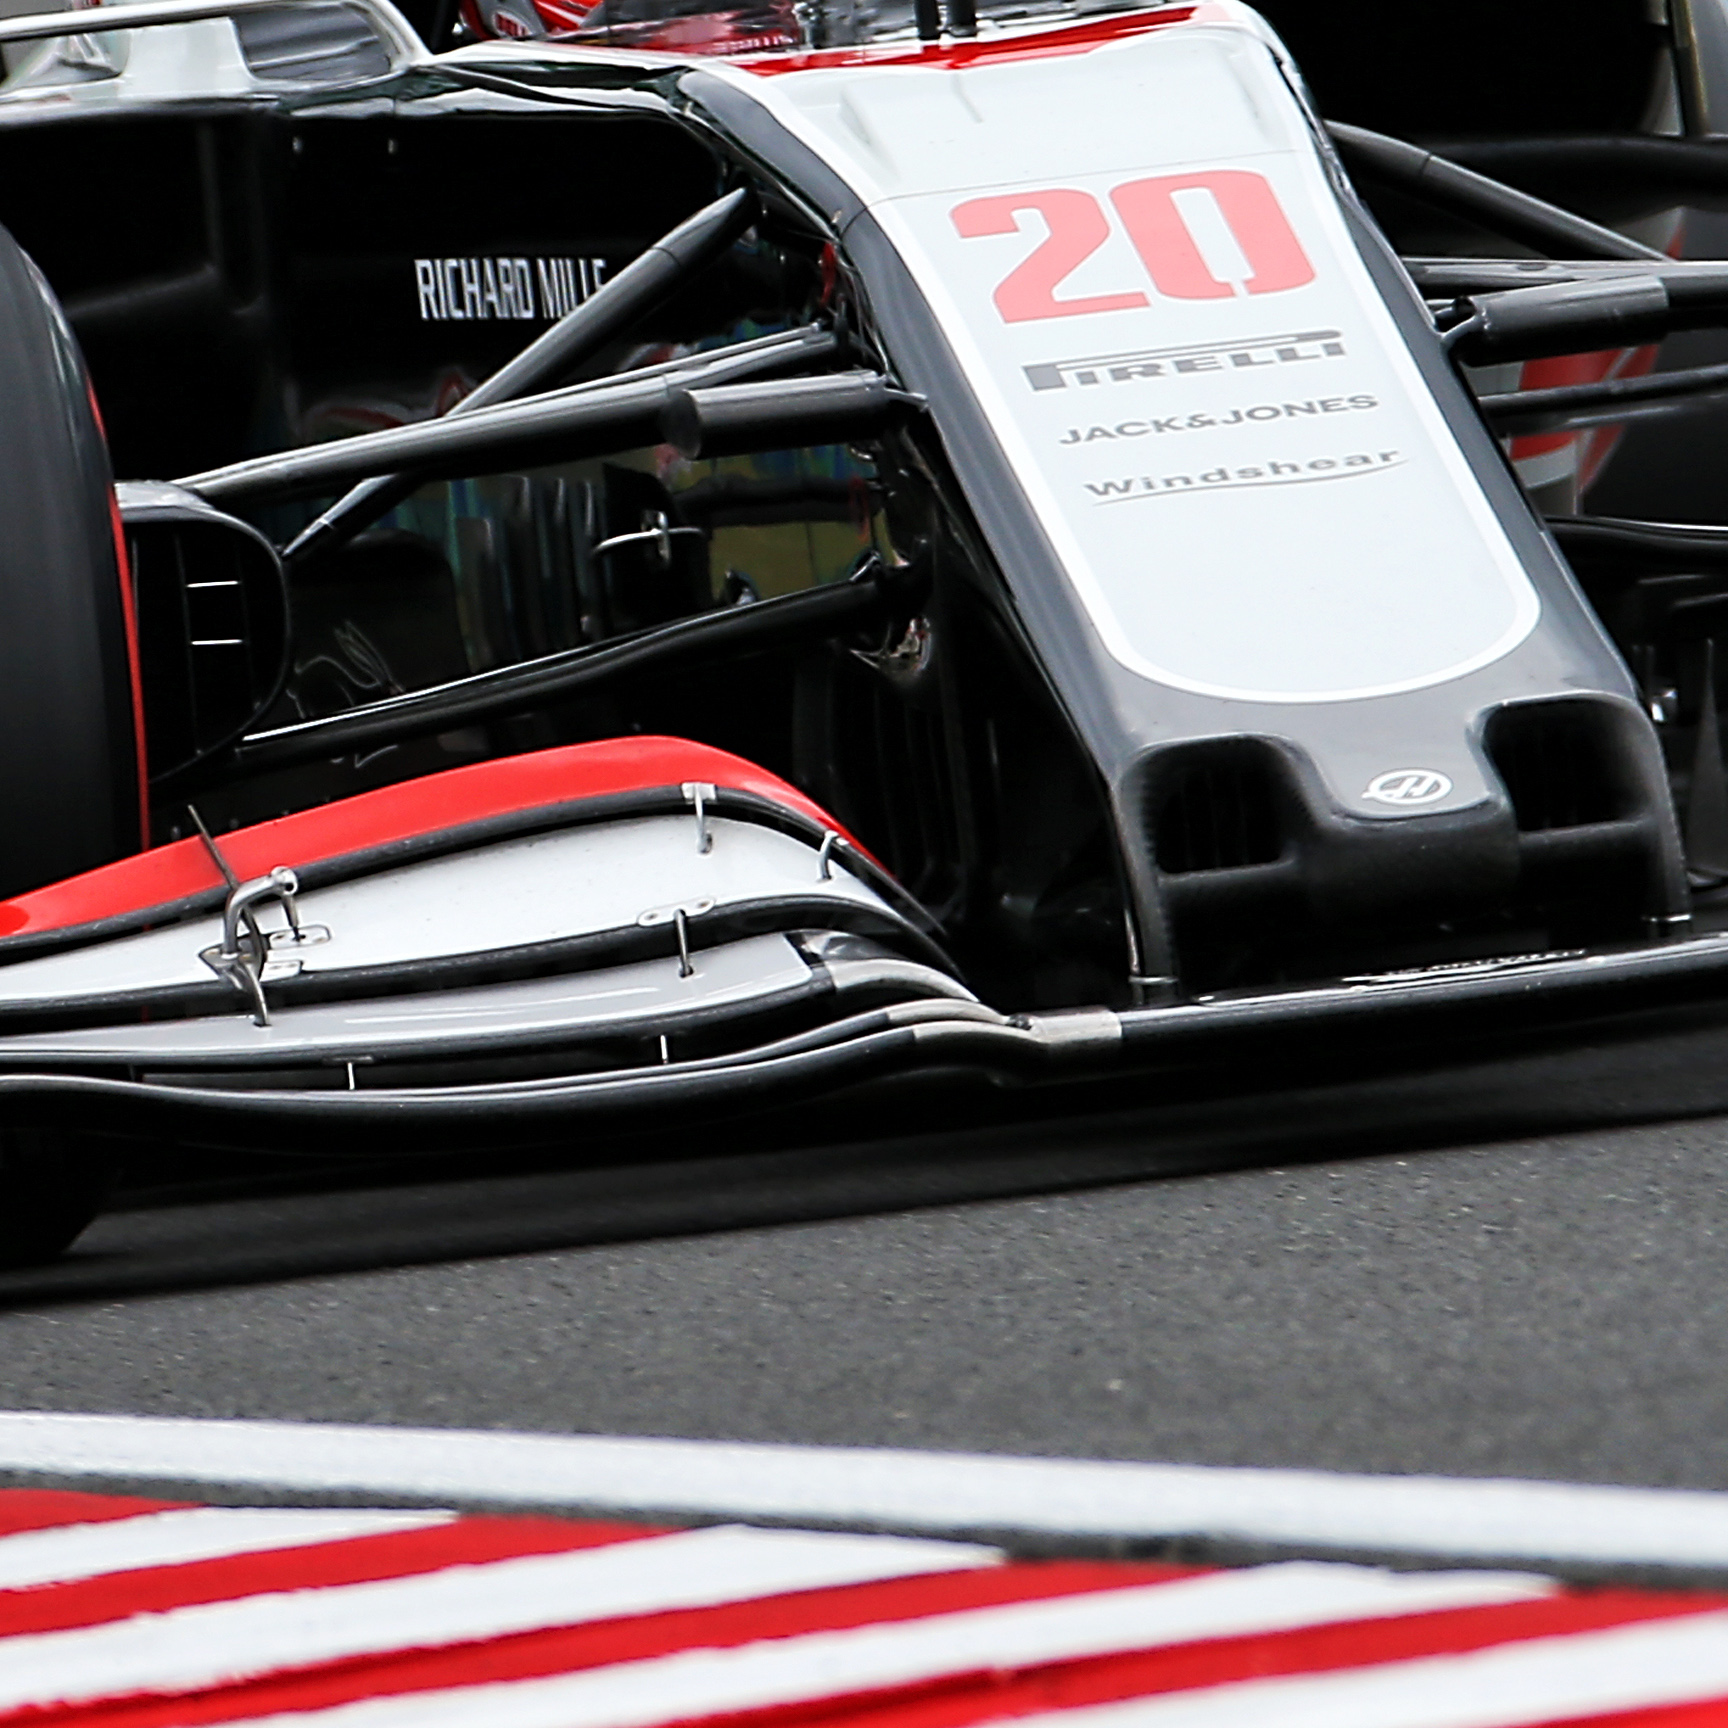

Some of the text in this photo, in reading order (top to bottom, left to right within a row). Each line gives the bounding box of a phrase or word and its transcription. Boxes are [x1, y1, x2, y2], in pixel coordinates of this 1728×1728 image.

[949, 169, 1317, 325] 20
[414, 258, 534, 320] RICHARD
[1021, 329, 1347, 392] PIRELLI
[1058, 394, 1379, 446] JACK&JONES
[1083, 448, 1402, 498] Windshear
